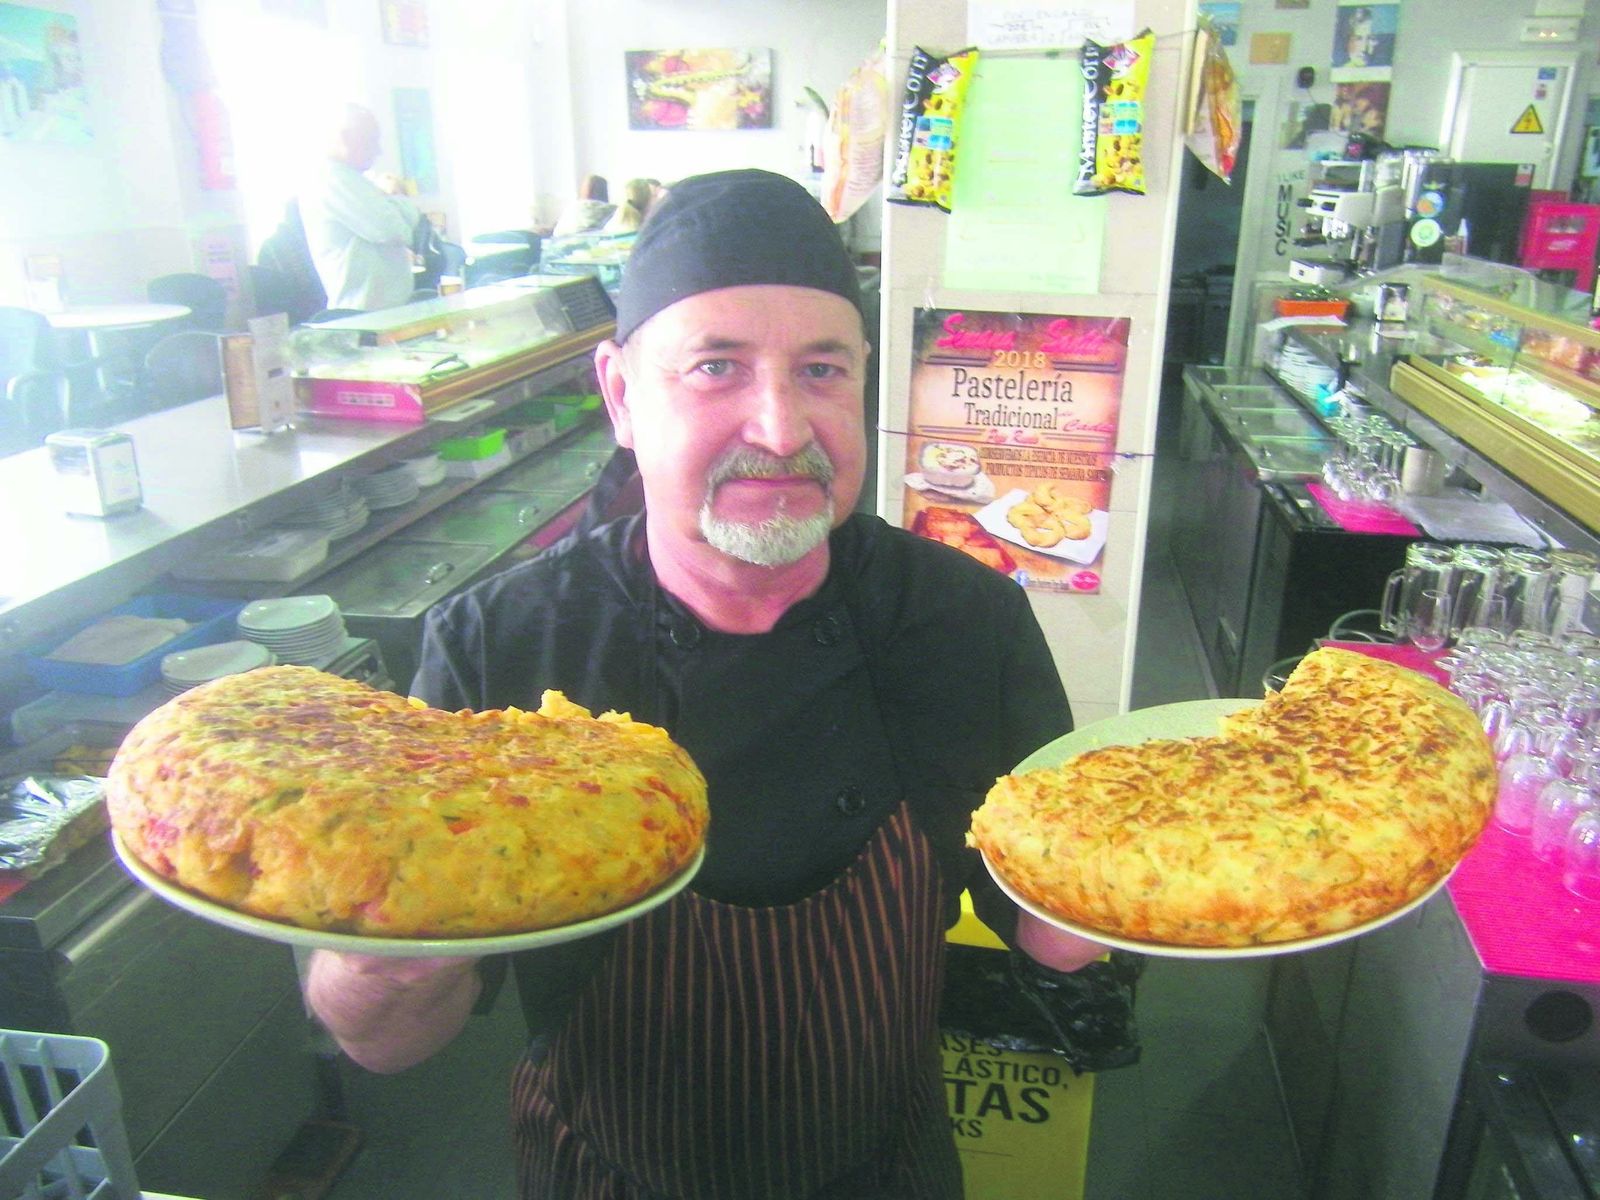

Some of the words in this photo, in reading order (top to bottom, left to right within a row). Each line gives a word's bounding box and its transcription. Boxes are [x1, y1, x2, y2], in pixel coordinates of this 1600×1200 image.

[993, 350, 1047, 369] 2018
[951, 367, 1073, 402] Pastelería
[964, 401, 1058, 431] Tradicional
[943, 1077, 1050, 1124] TAS
